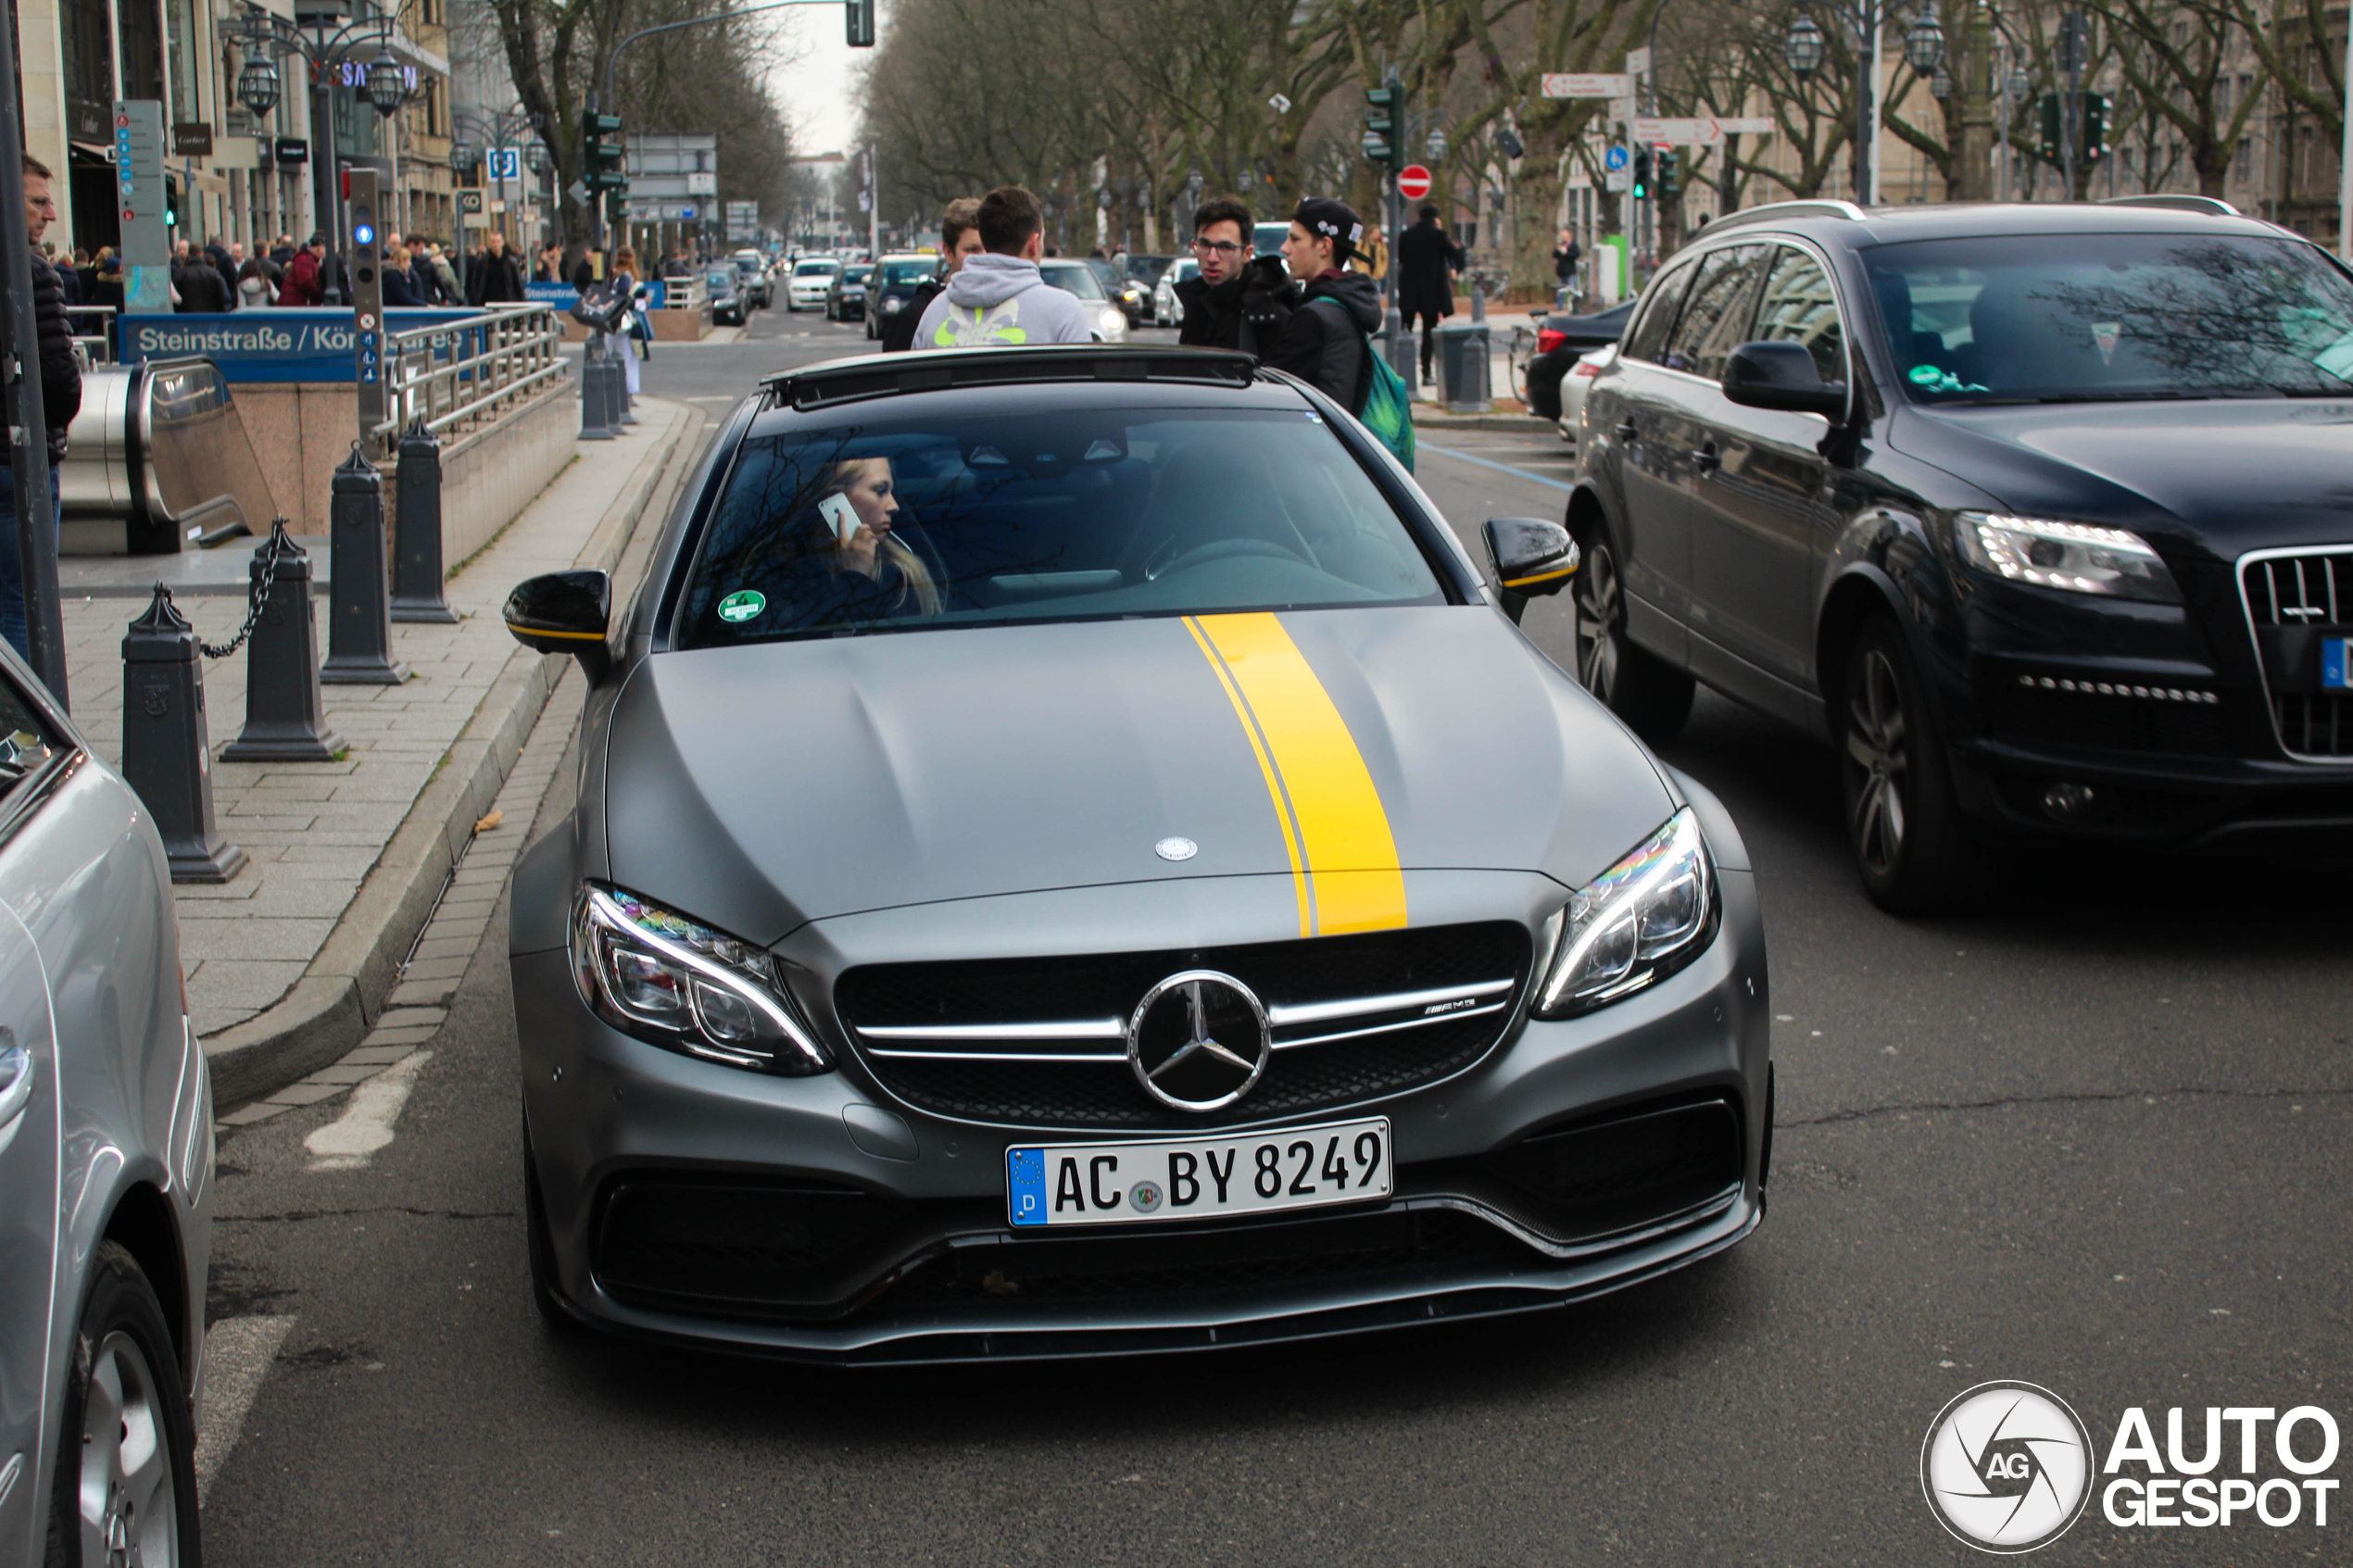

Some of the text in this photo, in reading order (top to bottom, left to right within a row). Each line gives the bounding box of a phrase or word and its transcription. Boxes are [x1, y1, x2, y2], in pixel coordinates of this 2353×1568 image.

[342, 62, 417, 90] SAN
[139, 326, 292, 352] Steinstraße
[1023, 1194, 1036, 1211] D
[1055, 1154, 1122, 1212] AC
[1167, 1147, 1237, 1207] BY
[1253, 1130, 1382, 1198] 8249
